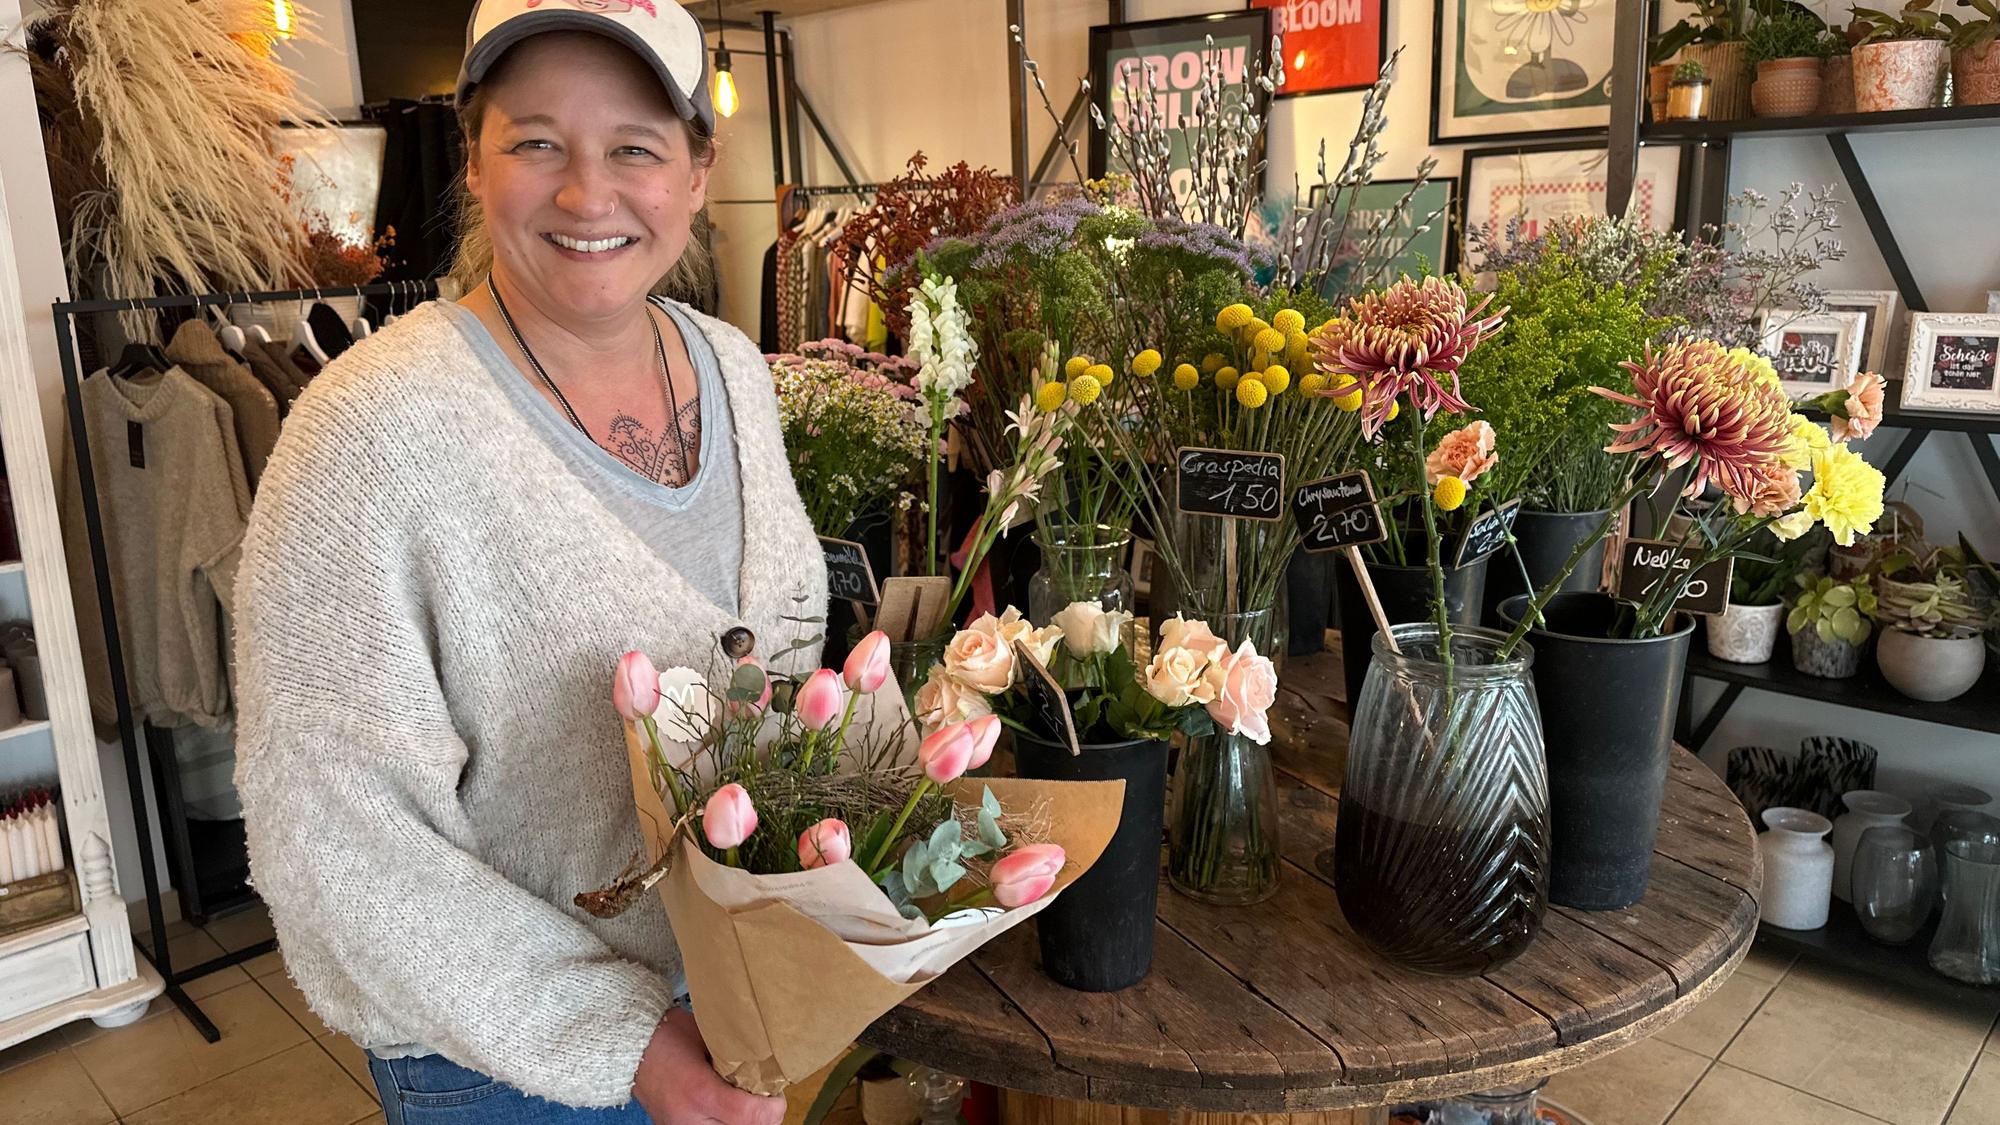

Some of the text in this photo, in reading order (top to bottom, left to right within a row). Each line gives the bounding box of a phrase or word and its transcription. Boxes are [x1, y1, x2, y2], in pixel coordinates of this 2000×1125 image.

[1272, 0, 1361, 34] BLOOM
[1113, 46, 1247, 94] GROW
[1940, 344, 1992, 362] Scheiße
[1208, 482, 1279, 513] 1,50
[1313, 508, 1370, 543] 2,70
[1633, 546, 1691, 569] Nelke
[827, 571, 861, 597] 1,70
